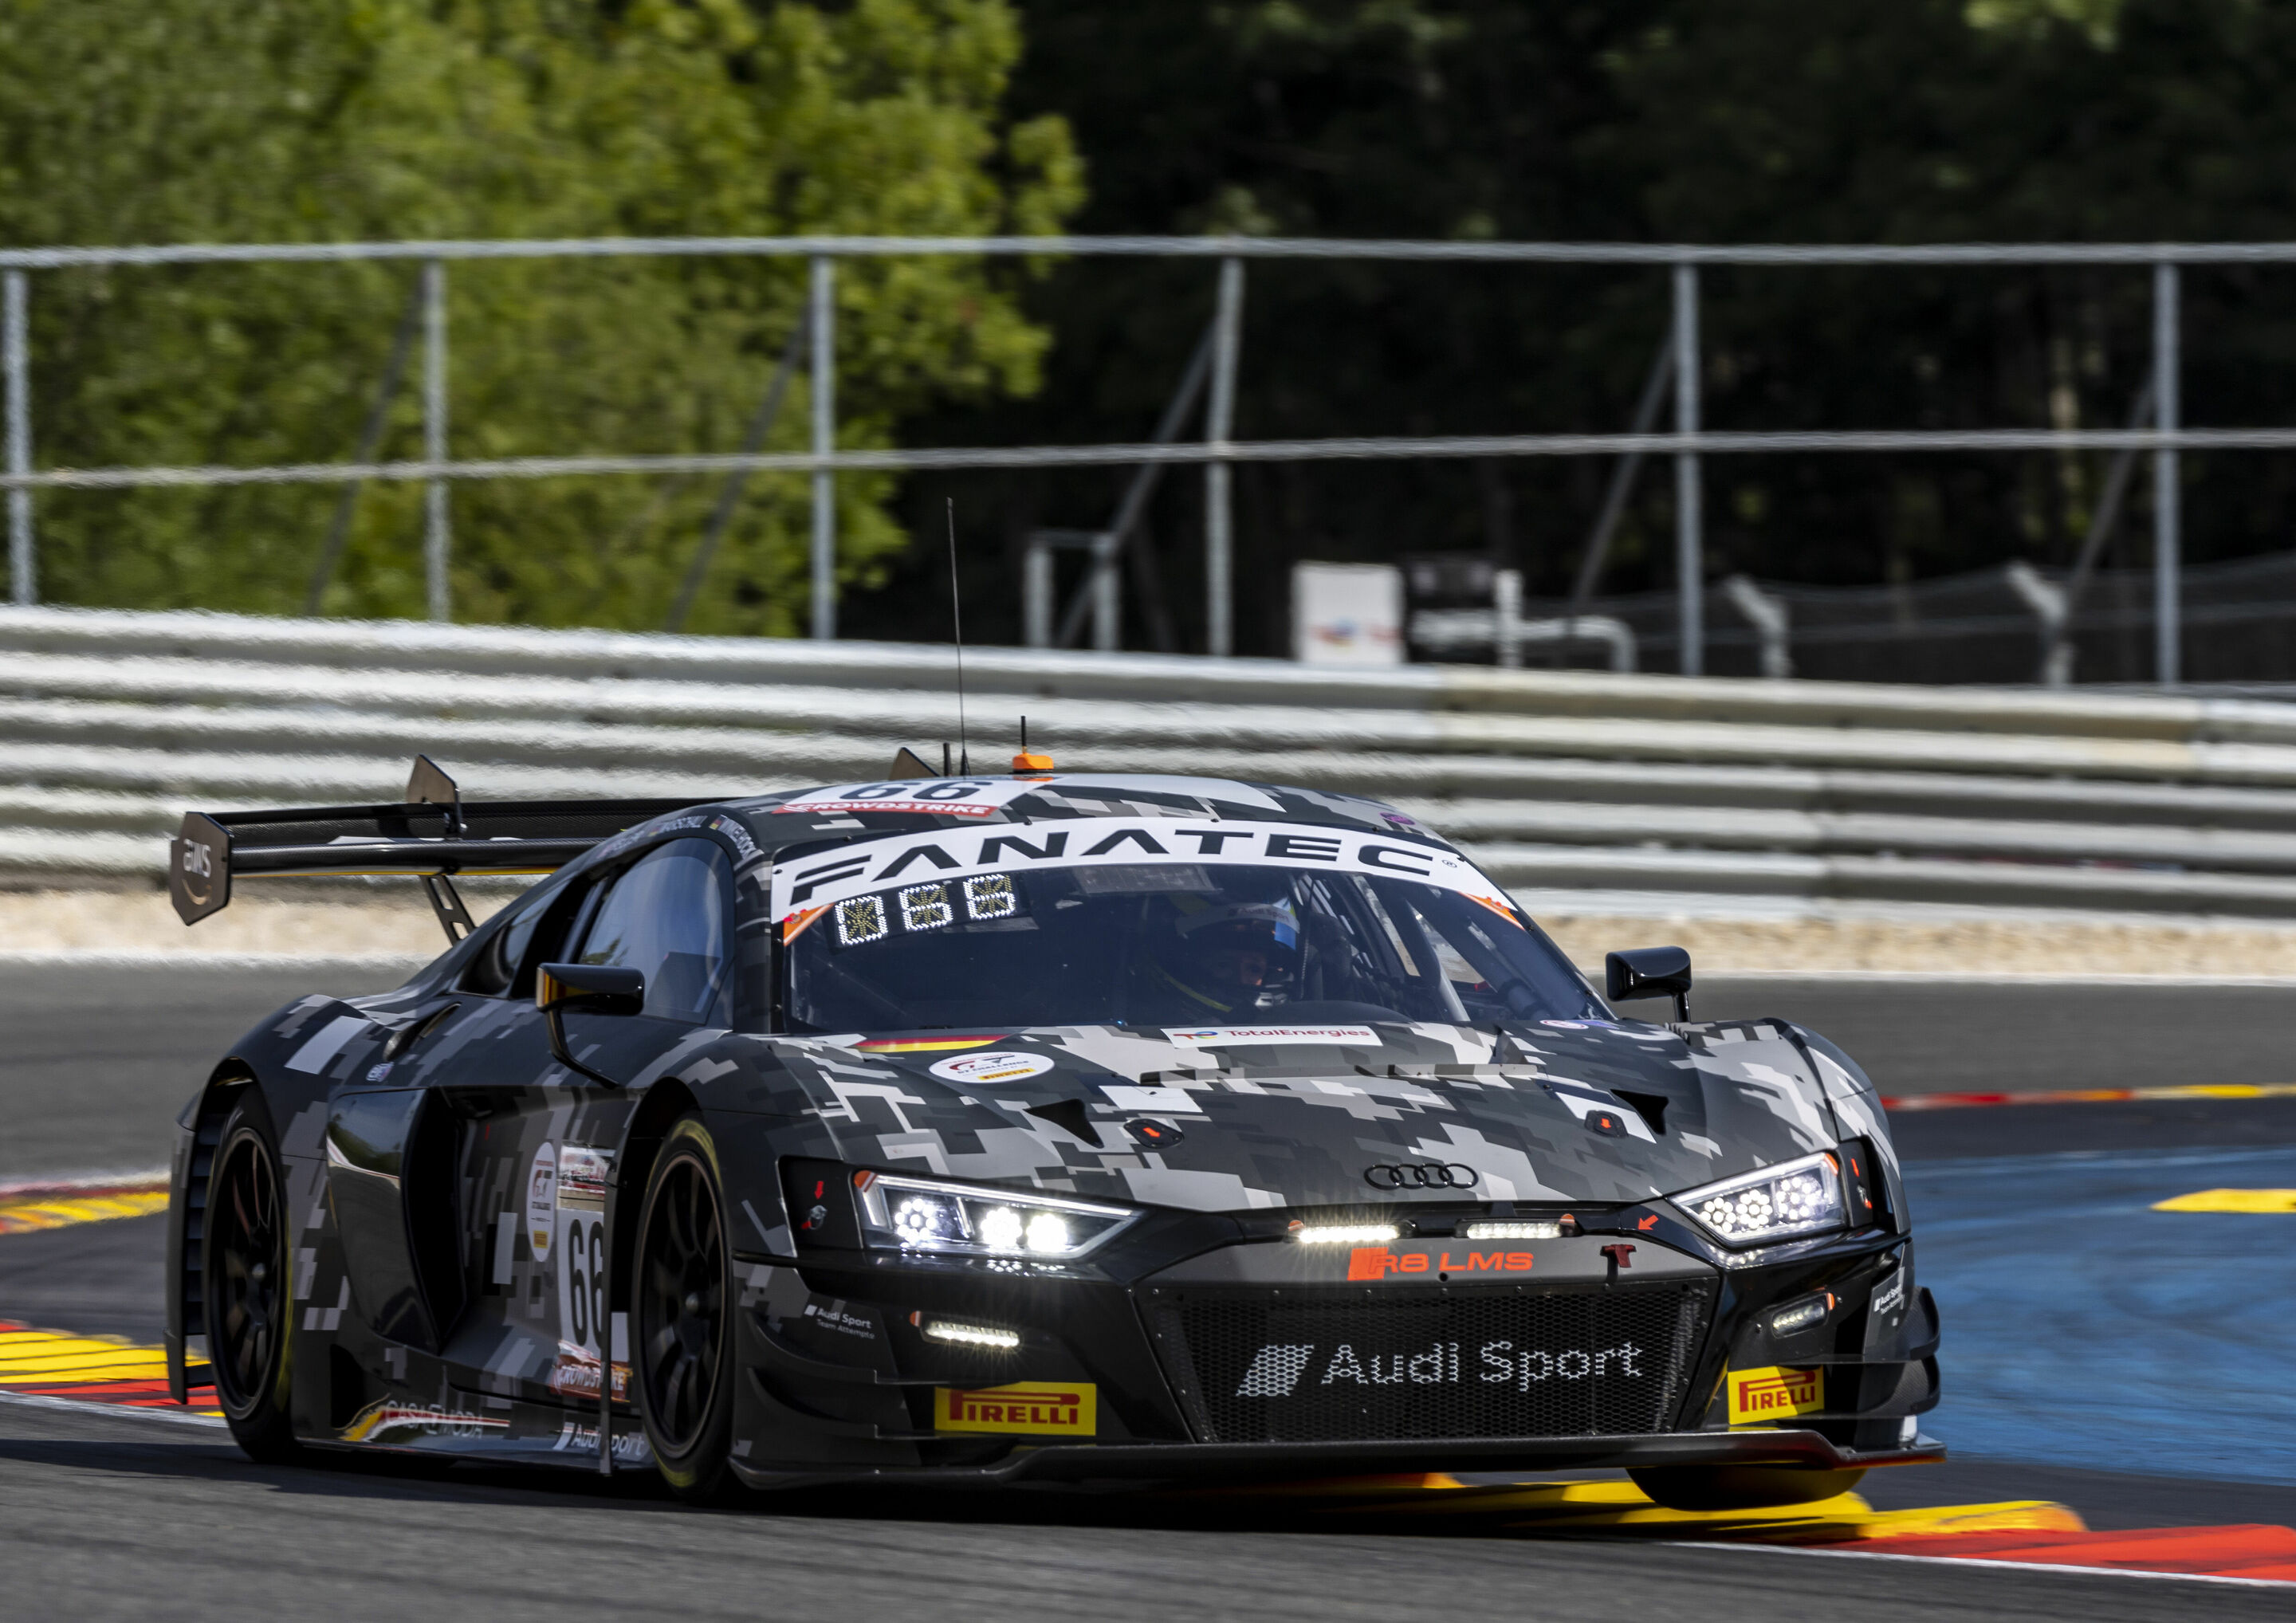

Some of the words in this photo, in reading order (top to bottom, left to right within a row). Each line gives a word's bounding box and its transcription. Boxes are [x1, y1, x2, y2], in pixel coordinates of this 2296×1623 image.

[839, 781, 993, 800] 66
[798, 802, 989, 814] CROWDSTRIKE
[790, 828, 1433, 906] FANATEC
[1368, 1253, 1429, 1274] R8
[1438, 1252, 1535, 1271] LMS
[817, 1307, 839, 1321] Audi
[842, 1313, 871, 1329] Sport
[558, 1364, 625, 1390] CROWDSTKE
[1321, 1342, 1460, 1385] Audi
[1480, 1340, 1642, 1392] Sport
[1739, 1371, 1816, 1413] PIRELLI
[948, 1389, 1080, 1425] PIRELLI
[611, 1433, 645, 1456] port
